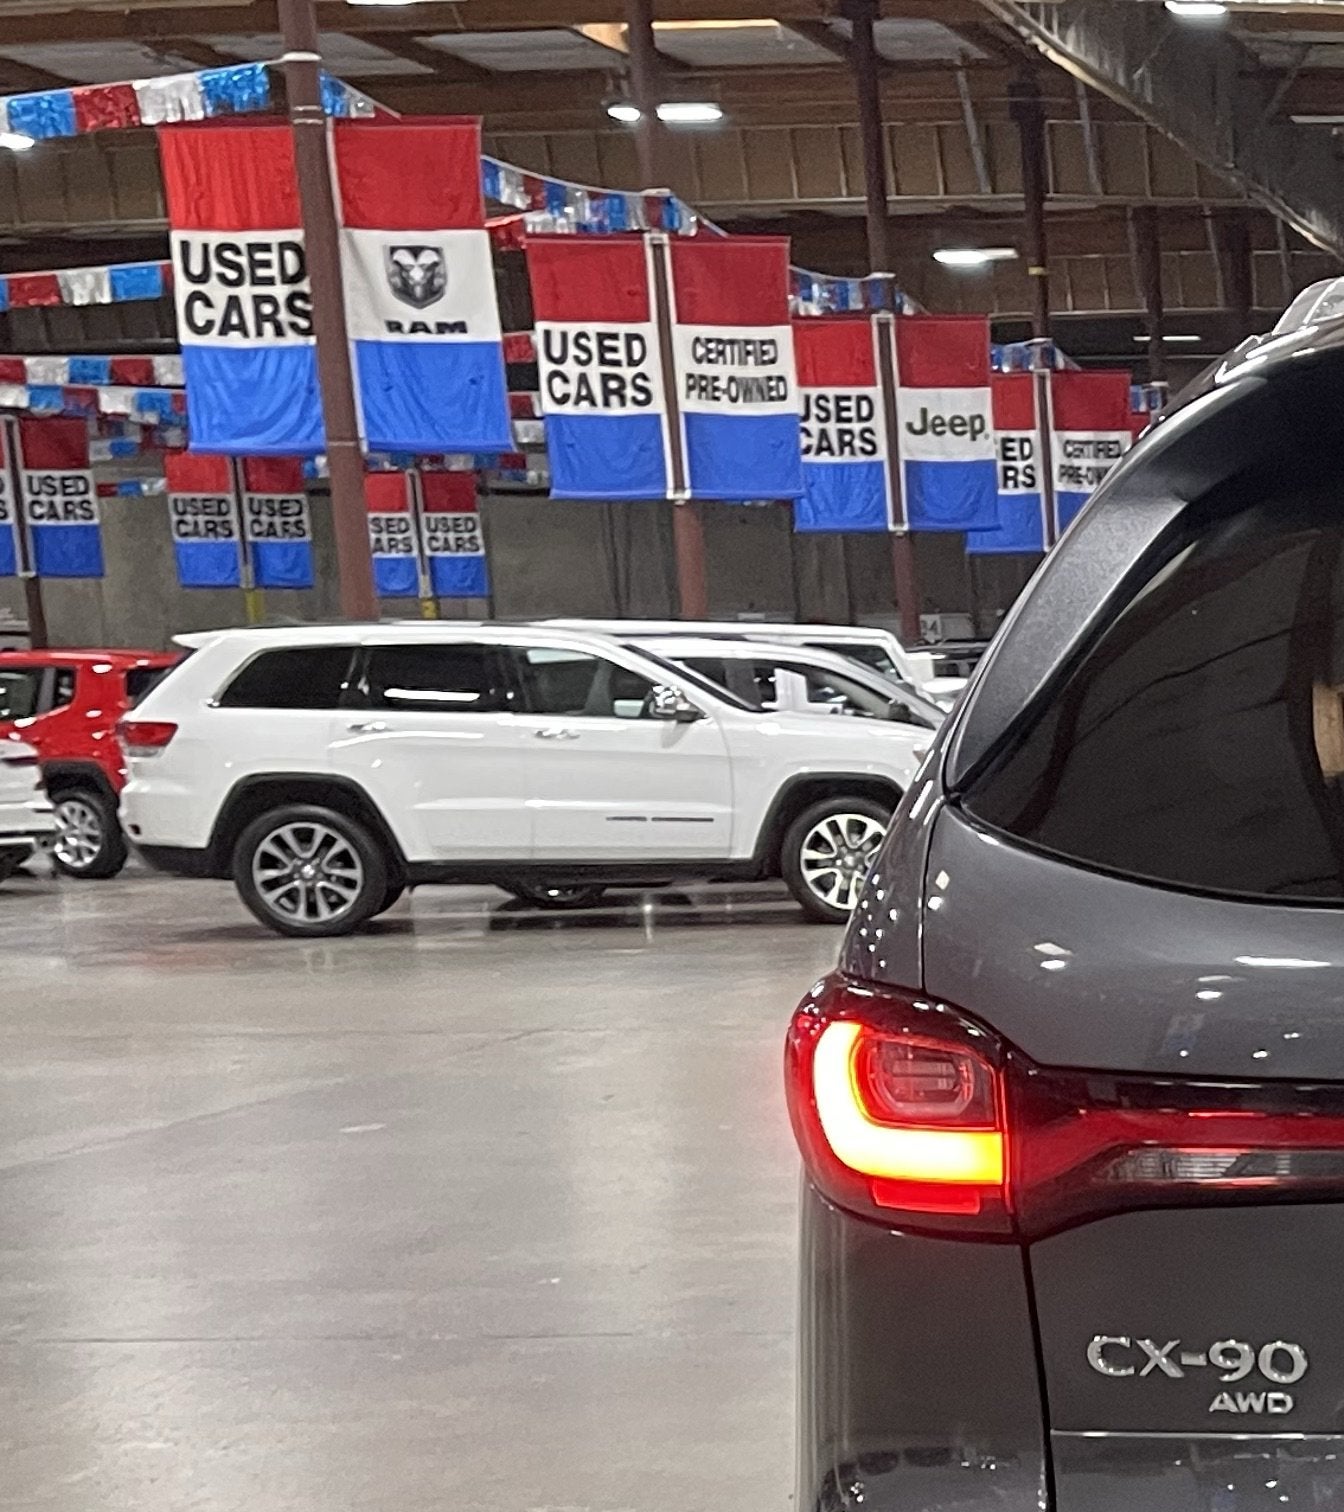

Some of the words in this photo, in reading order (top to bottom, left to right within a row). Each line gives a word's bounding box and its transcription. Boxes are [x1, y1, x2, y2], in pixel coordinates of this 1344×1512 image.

[179, 240, 308, 287] USED
[183, 290, 313, 338] CARS
[384, 319, 468, 335] RAM
[543, 329, 647, 367] USED
[691, 336, 778, 367] CERTIFIED
[547, 369, 653, 408] CARS
[685, 372, 788, 403] PRE-OWNED
[905, 407, 986, 441] Jeep
[1001, 437, 1034, 461] ED
[27, 475, 90, 496] USED
[1002, 464, 1036, 489] RS
[29, 500, 95, 521] CARS
[172, 496, 231, 517] USED
[249, 496, 304, 517] USED
[175, 519, 234, 539] CARS
[251, 519, 307, 539] CARS
[370, 516, 411, 534] SED
[425, 516, 477, 534] USED
[372, 536, 413, 554] ARS
[427, 536, 481, 554] CARS
[1086, 1335, 1309, 1384] CX-90
[1208, 1391, 1294, 1415] AWD
